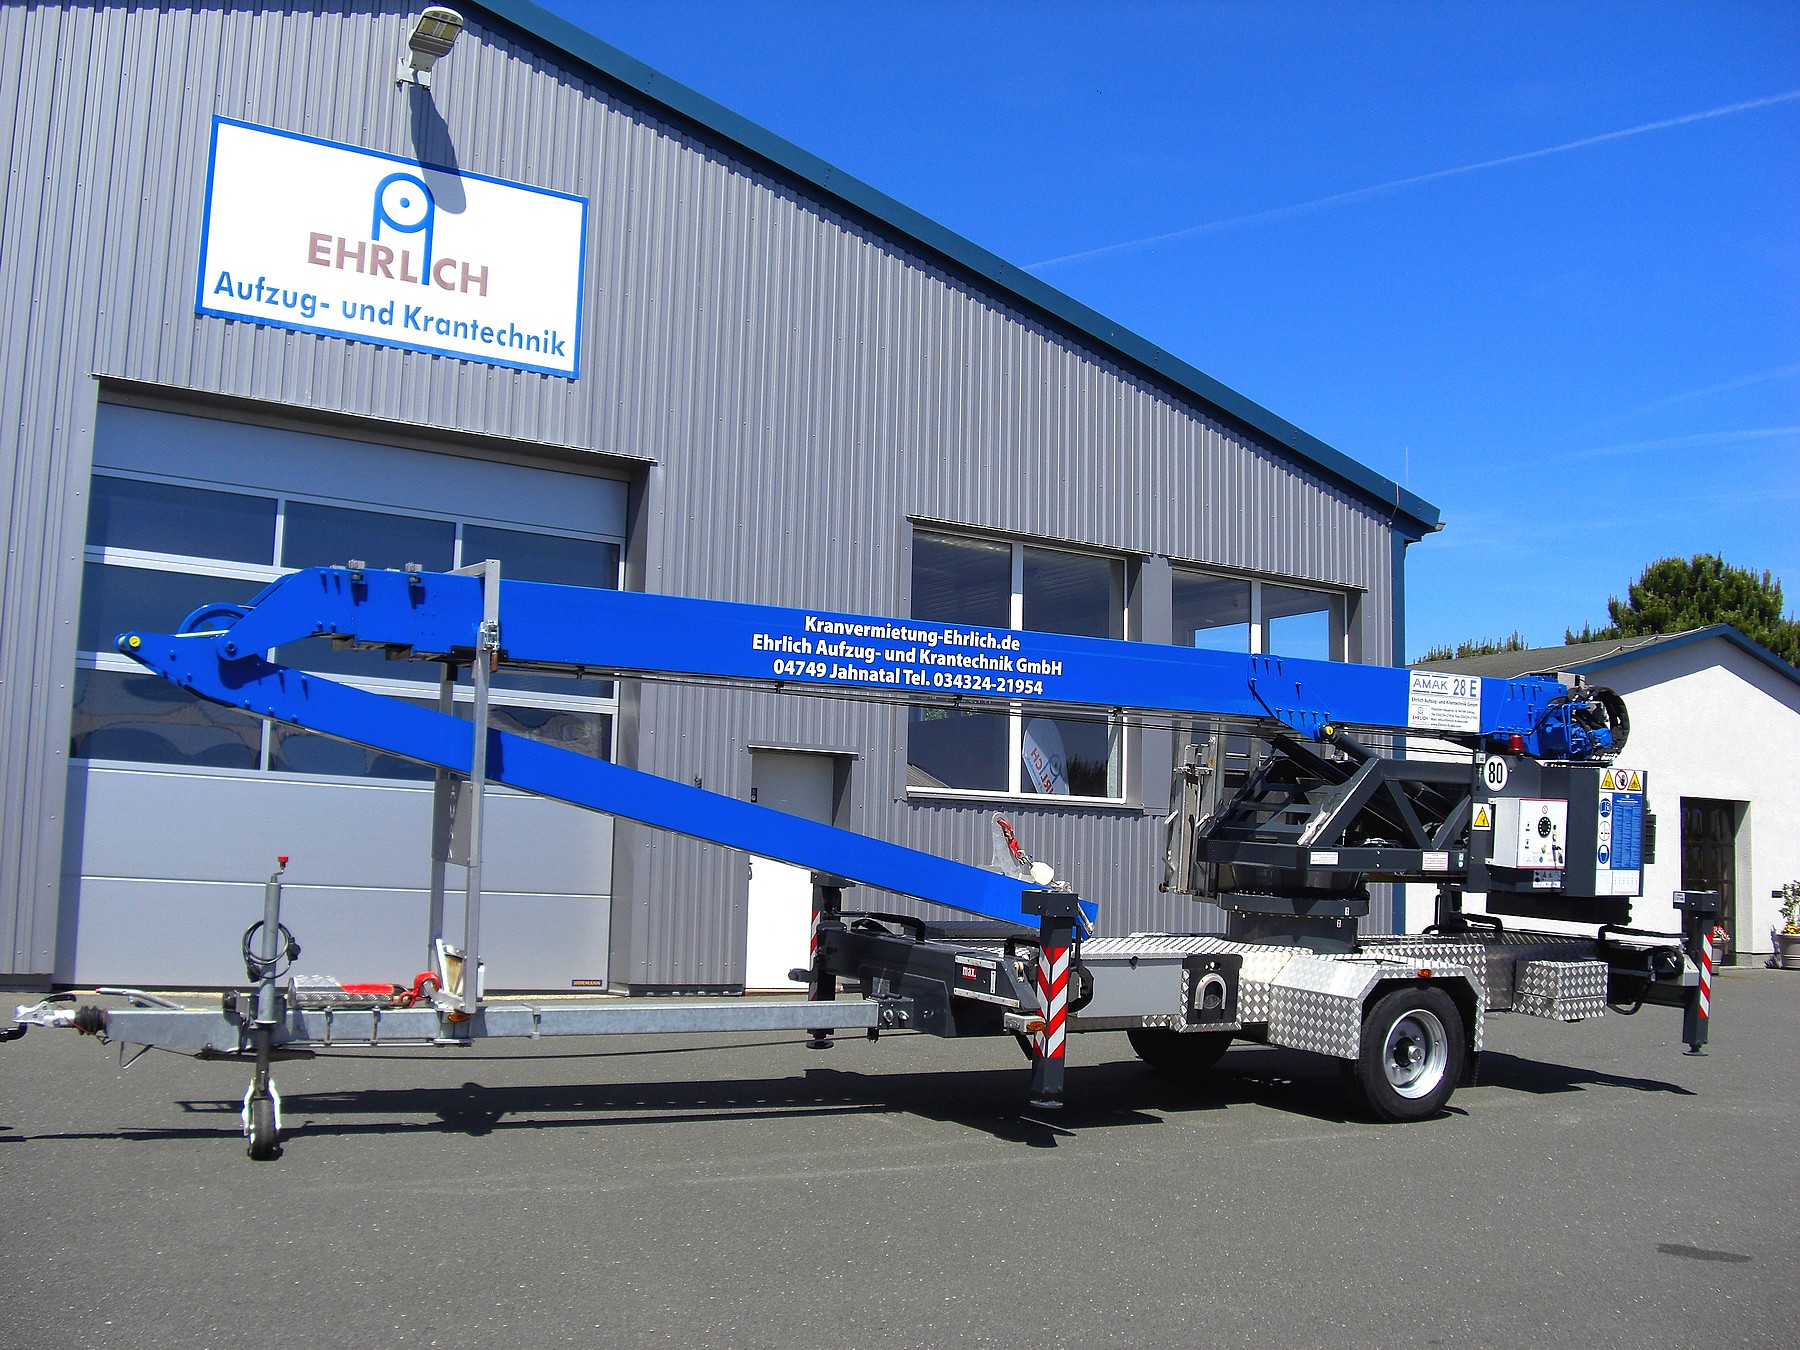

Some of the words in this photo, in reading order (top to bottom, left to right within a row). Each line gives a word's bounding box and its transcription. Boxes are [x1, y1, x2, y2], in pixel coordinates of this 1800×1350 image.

[308, 231, 489, 297] EHRLICH
[213, 271, 330, 319] Aufzug-
[341, 300, 394, 326] und
[403, 305, 566, 357] Krantechnik
[804, 615, 1020, 651] Kranvermietung-Ehrlich.de
[752, 633, 812, 655] Ehrlich
[815, 639, 882, 663] Aufzug-
[884, 646, 916, 664] und
[919, 649, 1013, 672] Krantechnik
[1015, 657, 1063, 676] GmbH
[773, 658, 827, 678] 04749
[829, 663, 900, 684] Jahnatal
[903, 668, 931, 687] Tel.
[933, 671, 1043, 696] 034324-21954
[1412, 678, 1448, 690] AMAK
[1453, 678, 1466, 696] 28
[1470, 680, 1477, 698] E
[1488, 761, 1503, 785] 80
